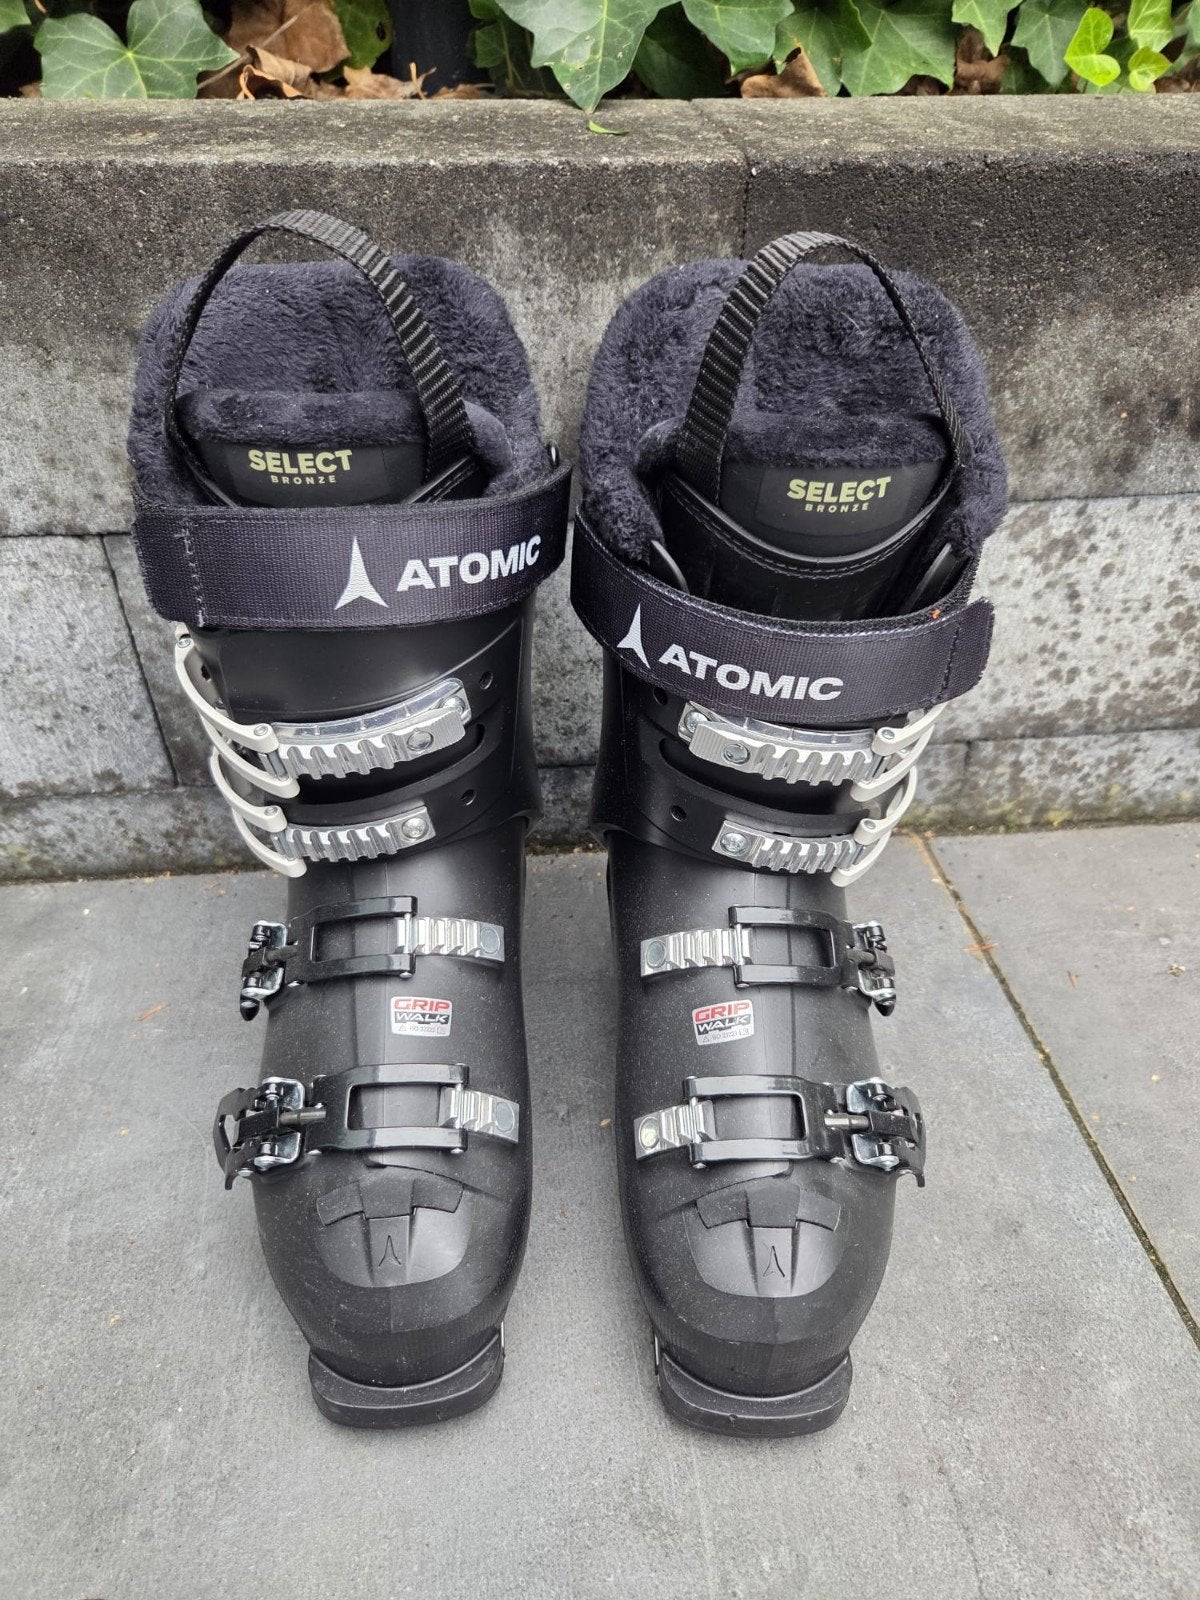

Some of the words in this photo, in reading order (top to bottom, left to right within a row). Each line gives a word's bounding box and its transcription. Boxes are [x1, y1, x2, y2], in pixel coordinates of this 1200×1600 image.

[248, 449, 352, 474] SELECT
[270, 474, 336, 485] BRONZE
[787, 476, 892, 503] SELECT
[804, 503, 869, 513] BRONZE
[397, 534, 541, 592] ATOMIC
[658, 643, 844, 701] ATOMIC
[394, 998, 450, 1012] GRIP
[695, 1002, 750, 1022] GRIP
[396, 1012, 449, 1023] WALK
[698, 1015, 750, 1033] WALK
